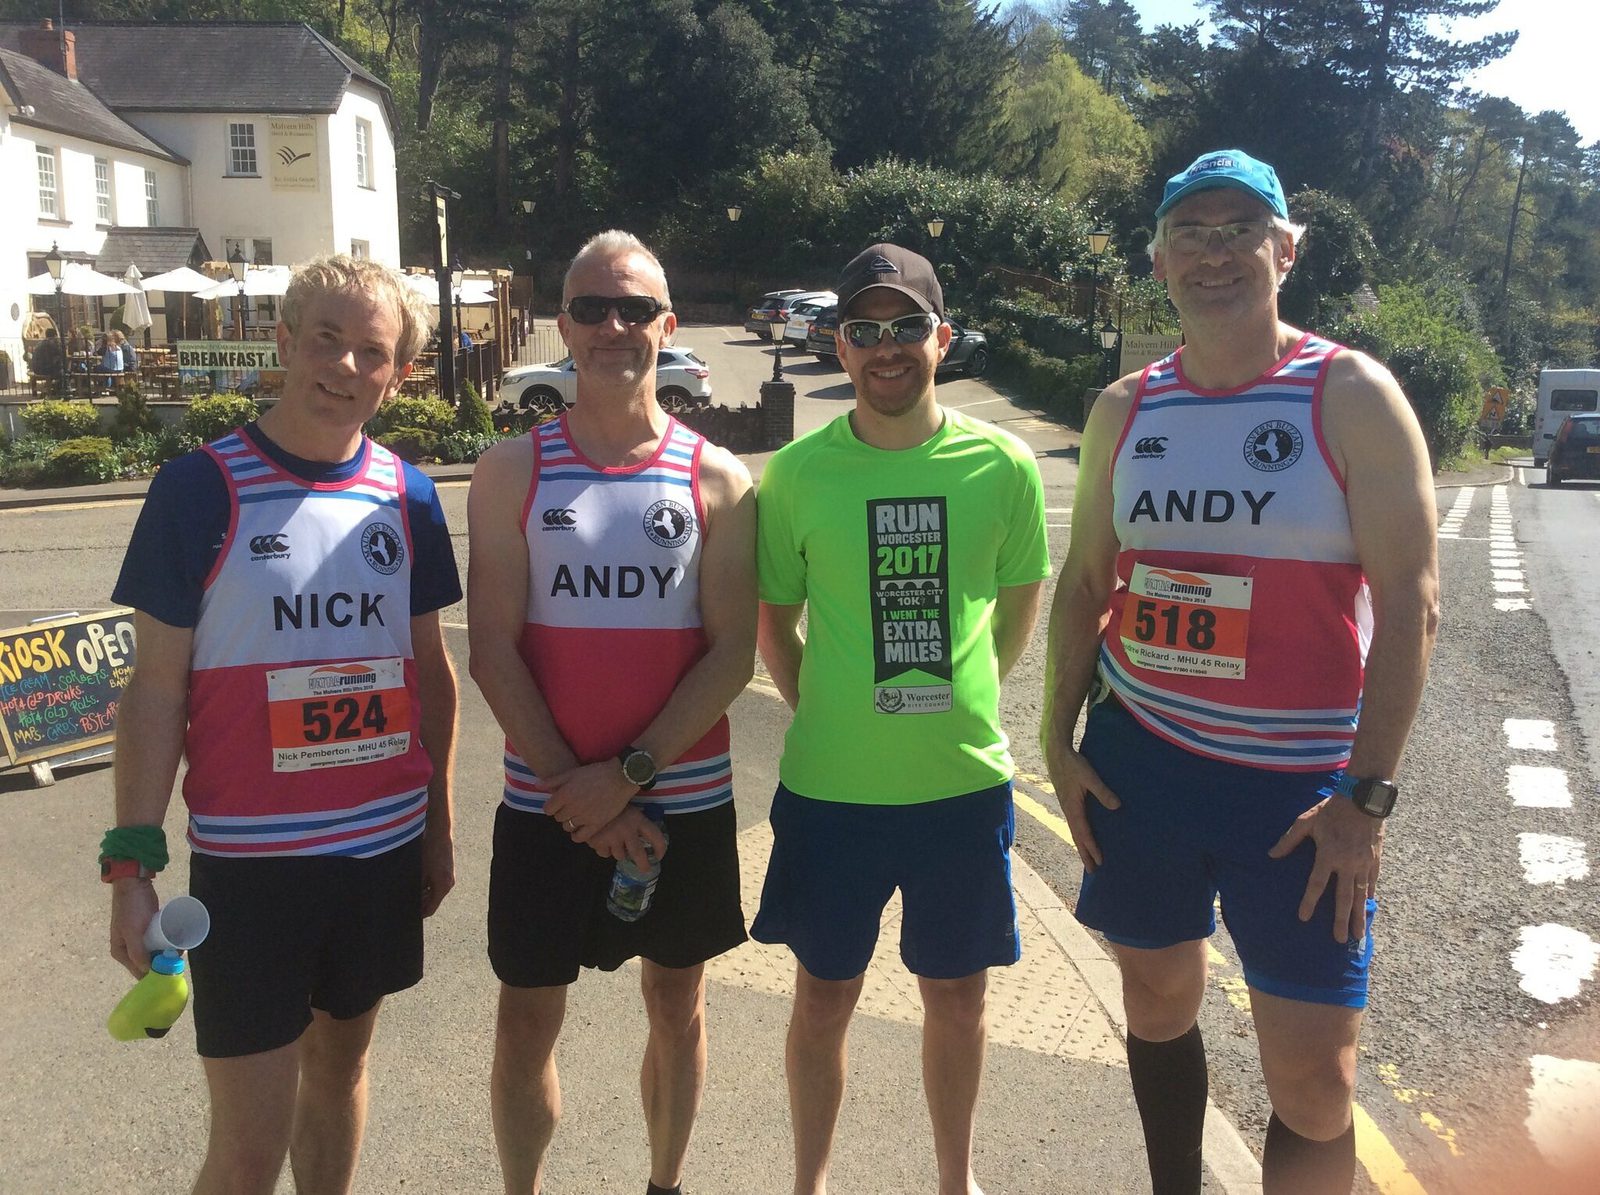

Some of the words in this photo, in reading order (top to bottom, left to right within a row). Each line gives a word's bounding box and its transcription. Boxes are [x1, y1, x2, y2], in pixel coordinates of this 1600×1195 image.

[1126, 340, 1158, 349] Malvern
[180, 352, 268, 368] BREAKFAST,
[272, 353, 280, 367] L
[1246, 422, 1272, 458] MALVERN
[1277, 421, 1302, 458] BUZZARDS
[1252, 459, 1290, 470] RUNNING
[1129, 490, 1276, 525] ANDY
[646, 501, 666, 532] MALVERN
[669, 502, 691, 536] BUZZARDS
[876, 504, 940, 534] RUN
[652, 535, 684, 546] RUNNING
[877, 532, 940, 545] WORCESTER
[250, 552, 290, 562] canterbury
[877, 544, 942, 576] 2017
[550, 564, 677, 598] ANDY
[876, 590, 925, 598] WORCESTER
[898, 597, 920, 606] 10K
[274, 592, 385, 630] NICK
[883, 611, 886, 620] I
[890, 610, 918, 620] WENT
[922, 609, 940, 620] THE
[882, 620, 942, 640] EXTRA
[1135, 600, 1216, 650] 518
[885, 641, 942, 662] MILES
[1140, 648, 1169, 660] Rickard
[1177, 656, 1198, 665] MHU
[1201, 658, 1212, 666] 45
[1214, 659, 1240, 670] Relay
[1, 684, 17, 701] ICE
[20, 673, 51, 695] CREAM
[109, 676, 130, 688] BAKE
[906, 693, 950, 702] Worcester
[44, 706, 68, 724] COLD
[80, 702, 120, 733] POSTCAR
[302, 694, 388, 742] 524
[278, 751, 298, 761] Nick
[300, 748, 350, 759] Pemberton
[358, 743, 378, 752] MHU
[388, 738, 407, 748] Relay
